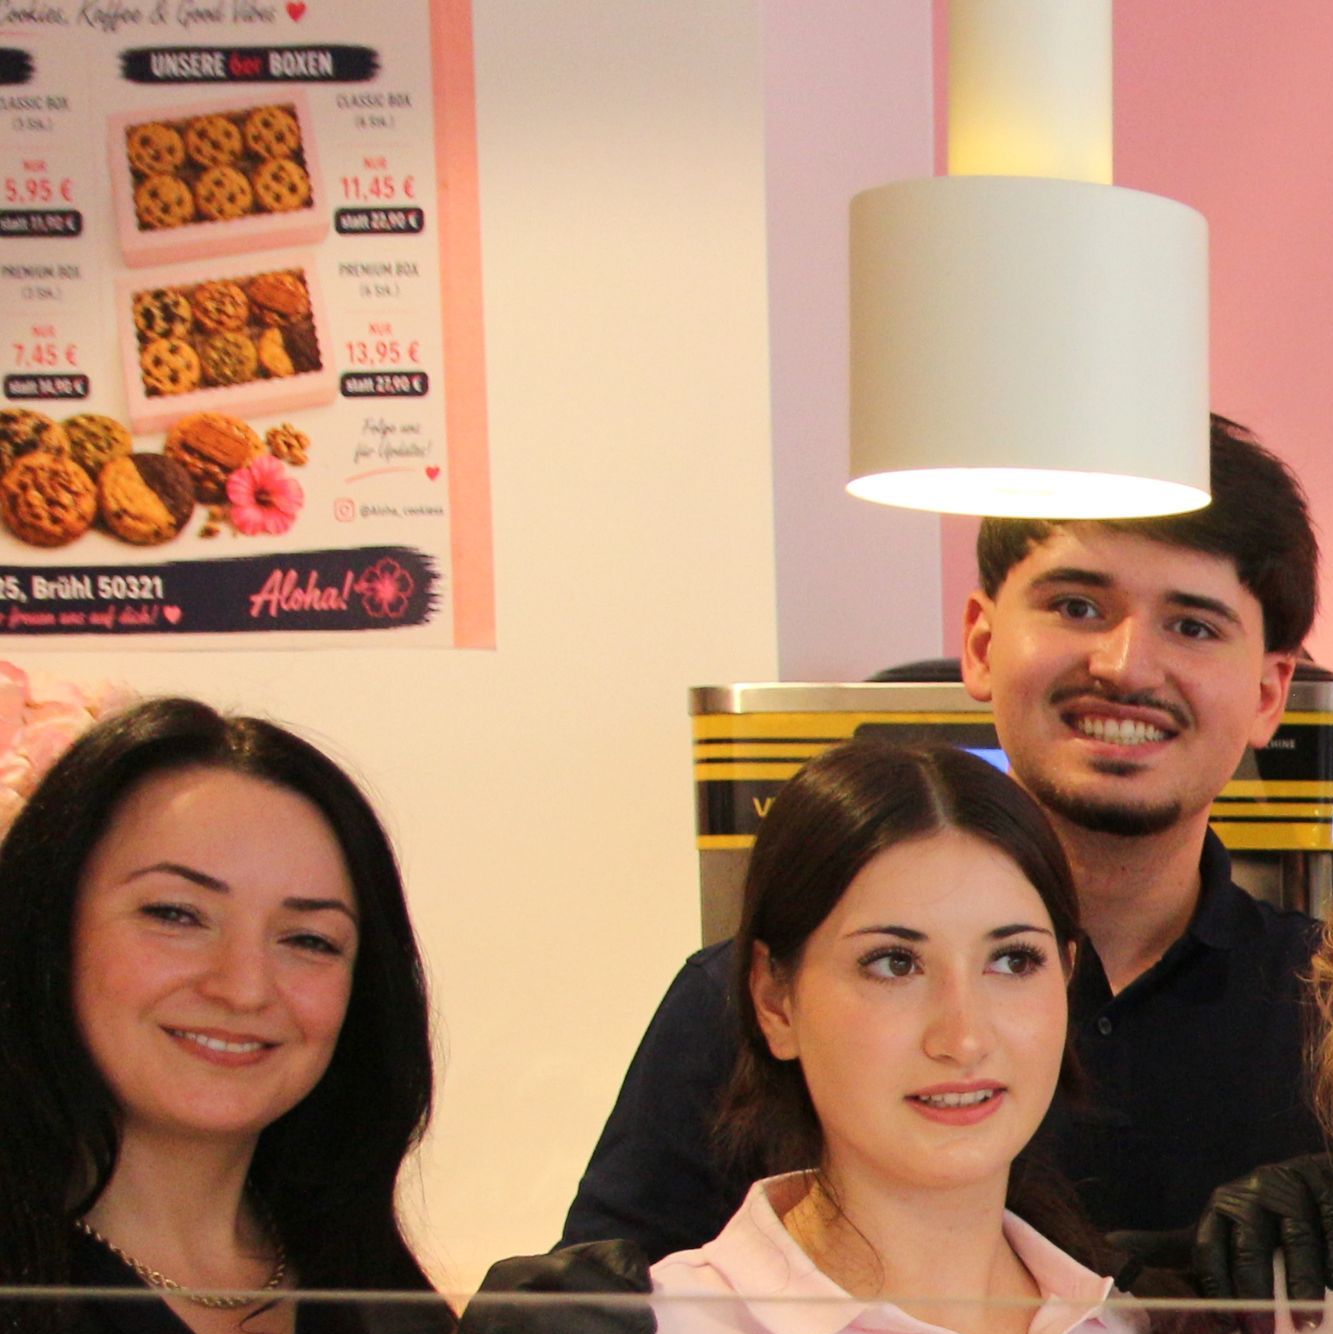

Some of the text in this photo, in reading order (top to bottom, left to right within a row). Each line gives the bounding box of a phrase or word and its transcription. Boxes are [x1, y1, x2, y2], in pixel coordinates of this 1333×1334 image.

[150, 52, 226, 78] UNSERE
[269, 51, 333, 77] BOXEN
[32, 574, 95, 600] Brühl
[98, 574, 164, 600] 50321
[250, 567, 355, 618] Aloha!
